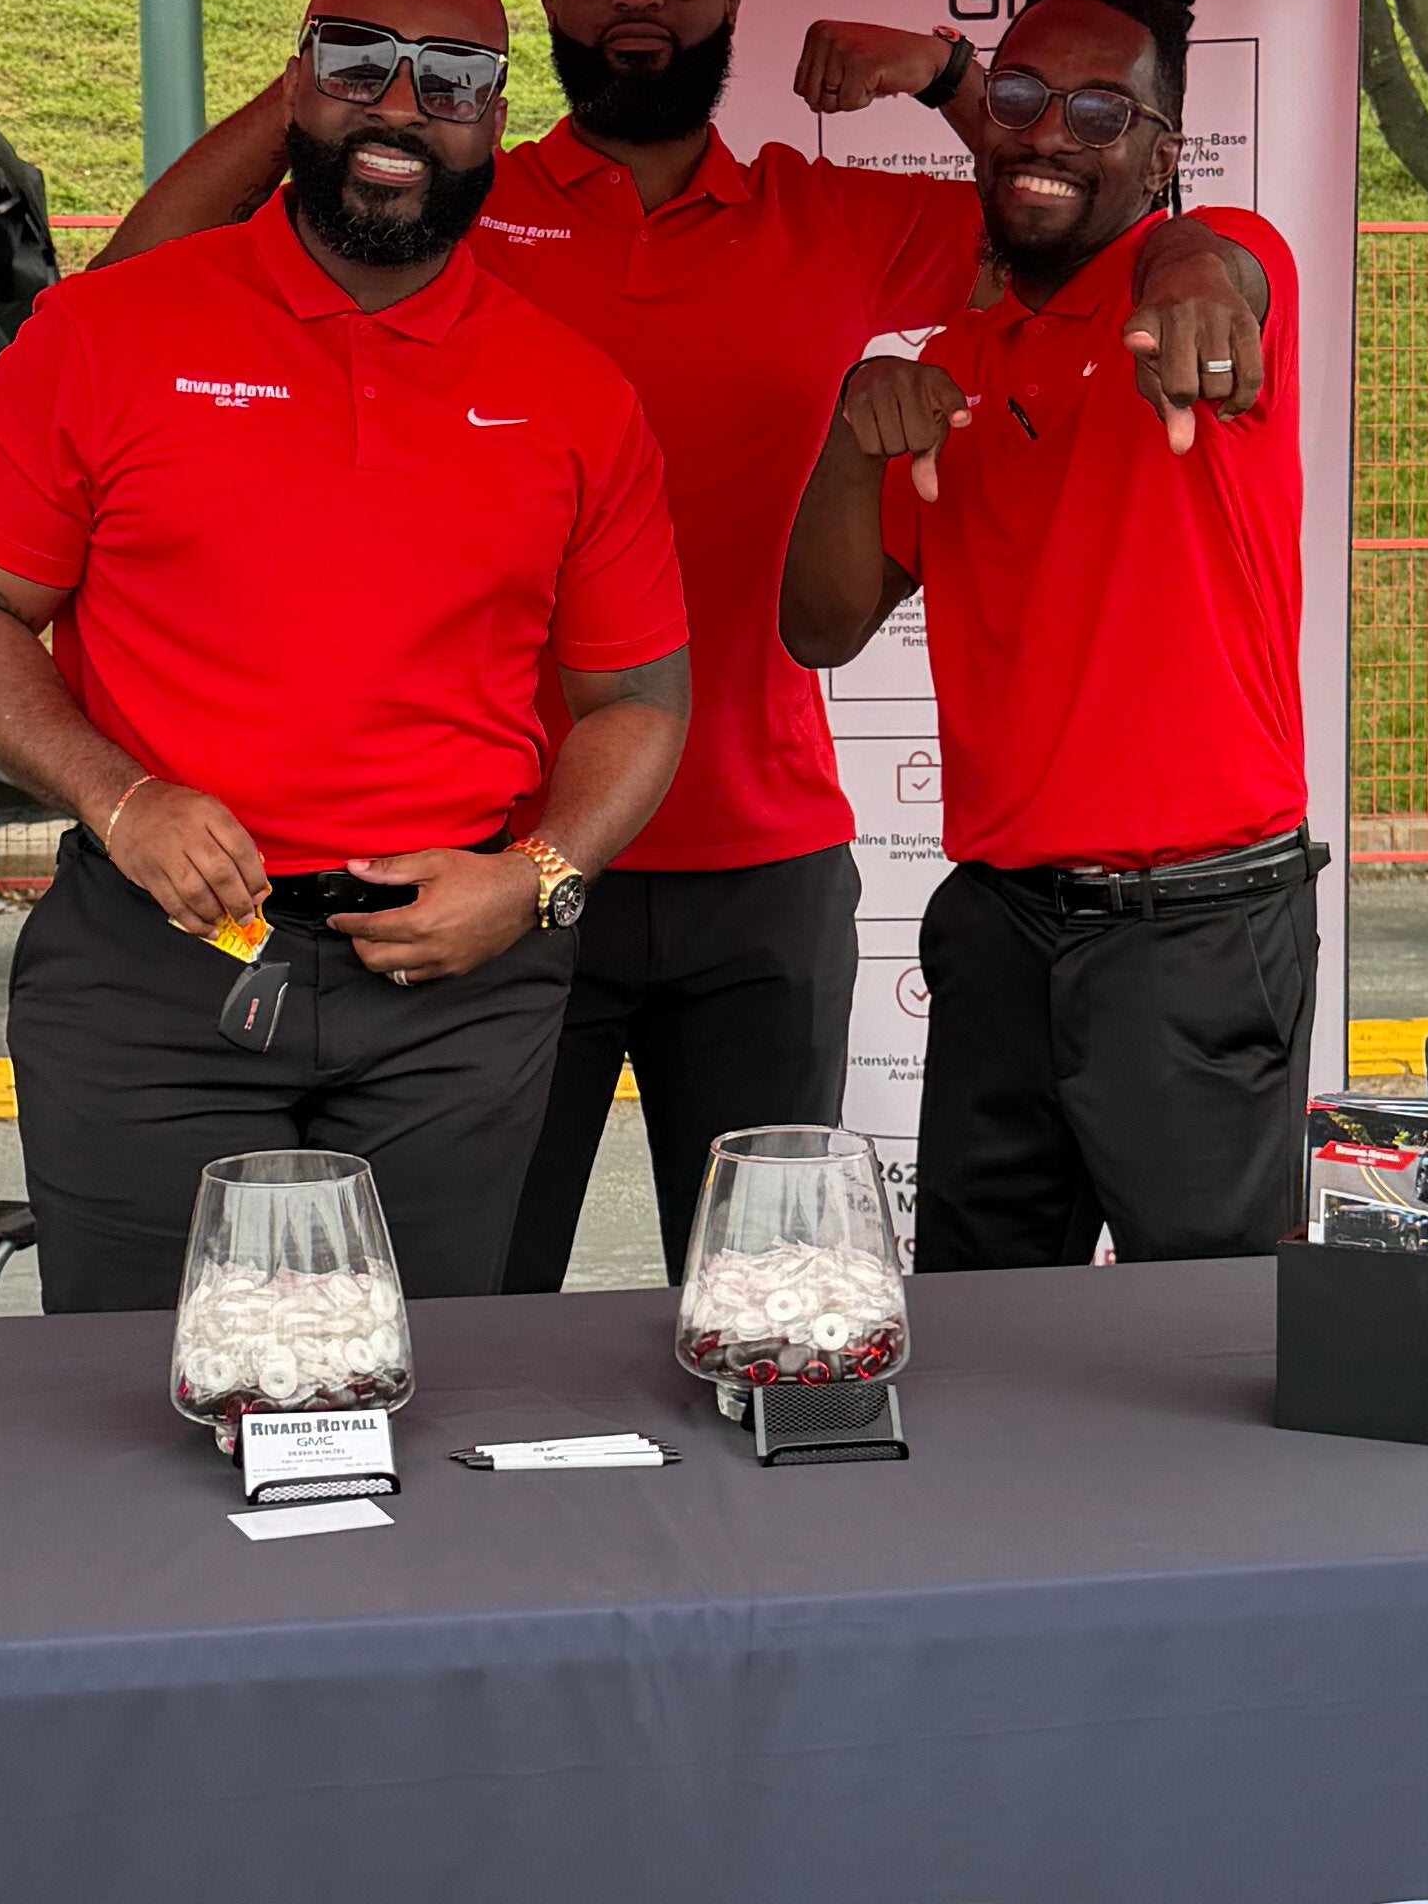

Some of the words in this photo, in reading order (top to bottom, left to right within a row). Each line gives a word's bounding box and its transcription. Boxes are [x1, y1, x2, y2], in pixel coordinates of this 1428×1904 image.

[882, 153, 899, 167] of
[902, 153, 927, 166] the
[214, 397, 250, 408] GMC
[890, 833, 940, 848] Buying
[296, 1435, 334, 1447] GMC
